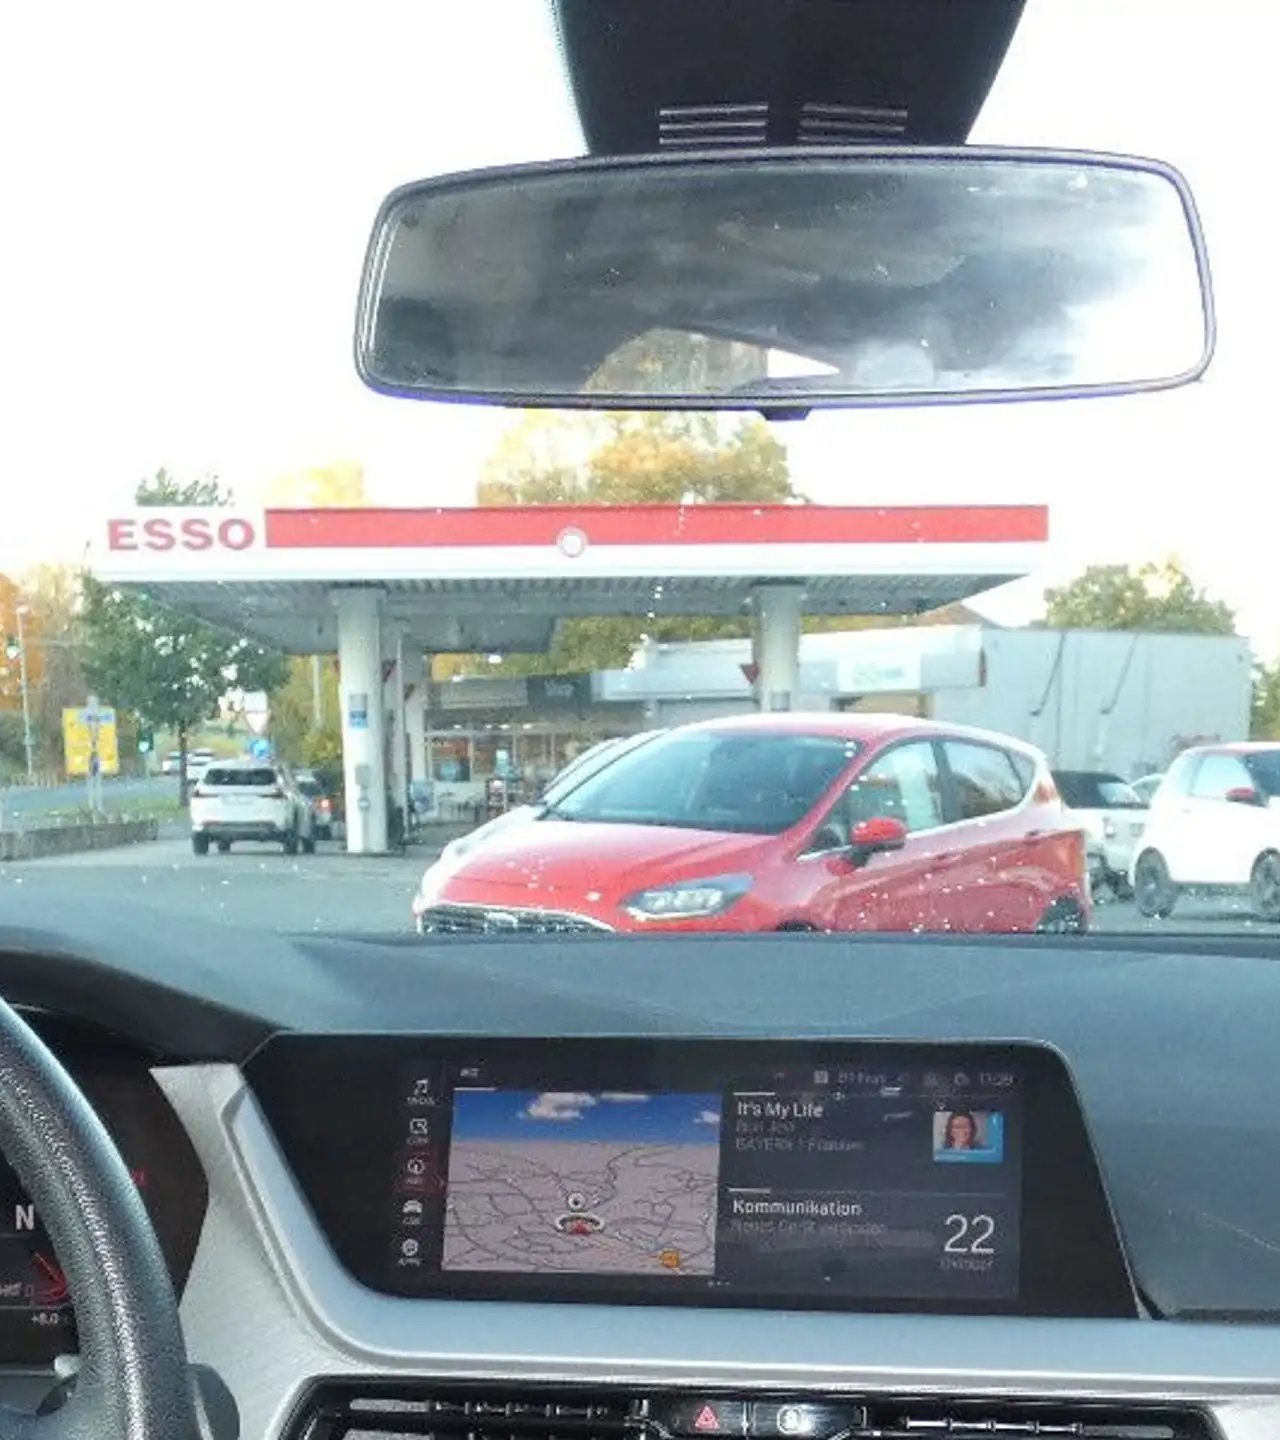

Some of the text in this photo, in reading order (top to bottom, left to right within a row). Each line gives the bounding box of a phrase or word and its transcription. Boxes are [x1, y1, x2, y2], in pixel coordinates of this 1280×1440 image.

[107, 518, 256, 551] ESSO
[738, 1102, 824, 1119] It's My Life
[16, 1204, 34, 1230] N
[733, 1199, 862, 1217] Kommunikation
[944, 1214, 996, 1254] 22
